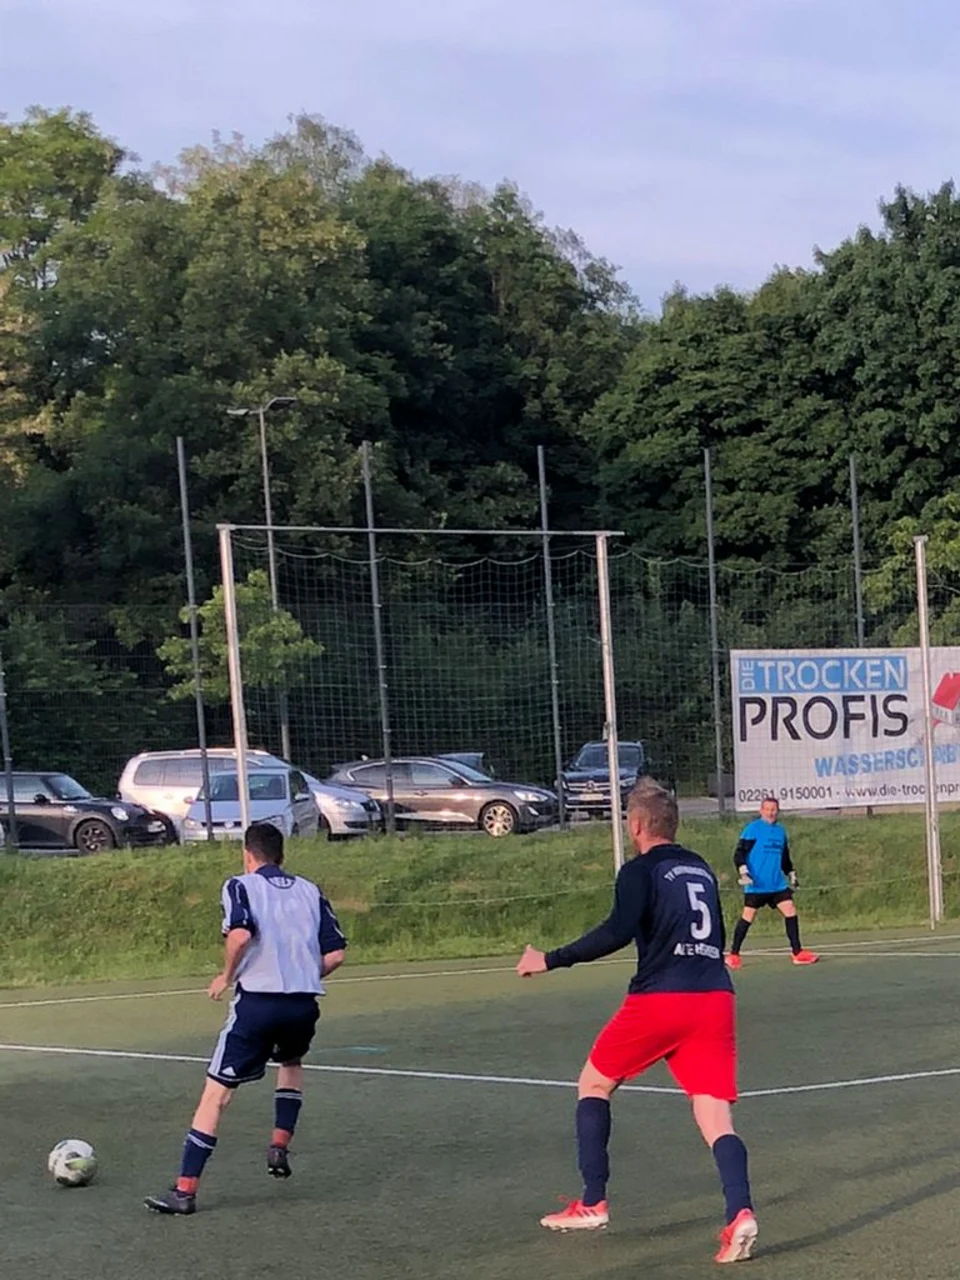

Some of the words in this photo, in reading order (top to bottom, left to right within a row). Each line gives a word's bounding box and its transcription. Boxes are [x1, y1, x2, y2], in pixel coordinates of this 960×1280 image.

[741, 659, 755, 691] DIE
[757, 658, 905, 691] TROCKEN
[738, 694, 909, 742] PROFIS
[779, 785, 833, 801] 9150001
[686, 881, 712, 940] 5
